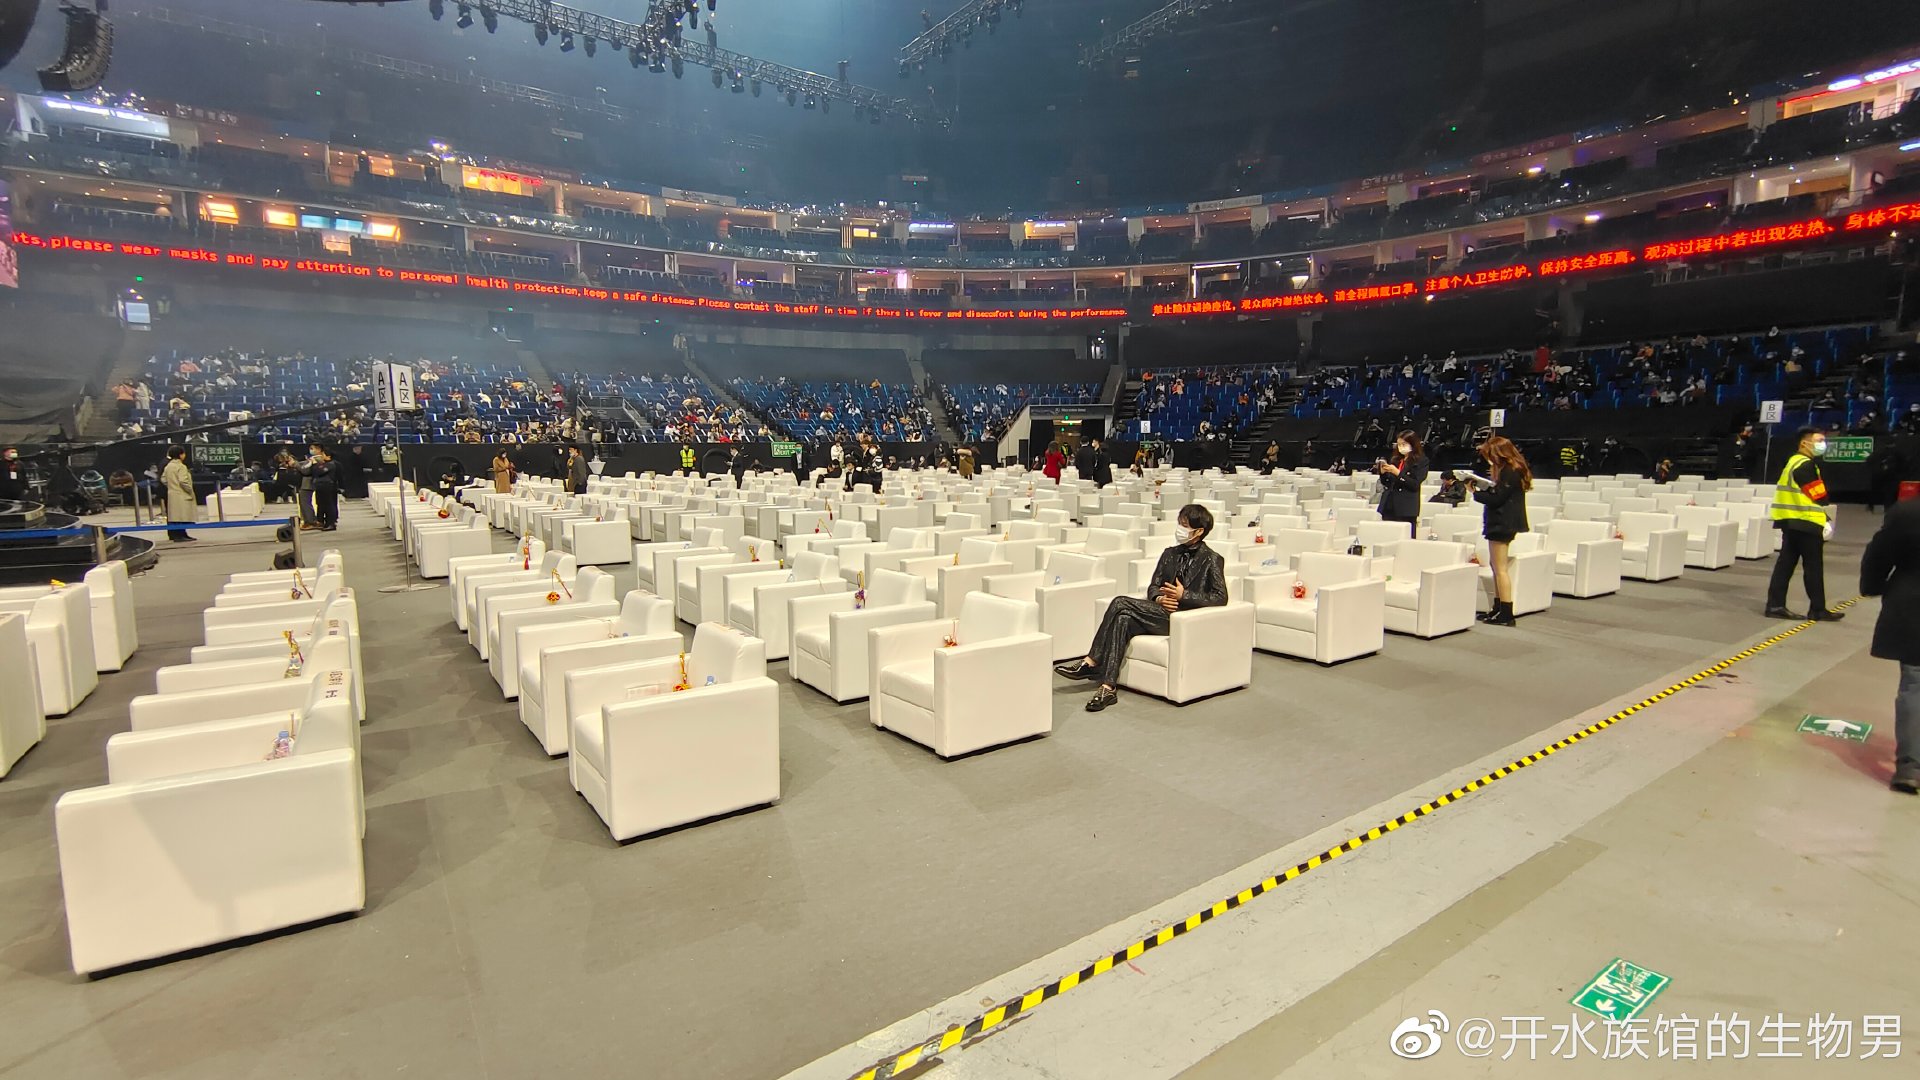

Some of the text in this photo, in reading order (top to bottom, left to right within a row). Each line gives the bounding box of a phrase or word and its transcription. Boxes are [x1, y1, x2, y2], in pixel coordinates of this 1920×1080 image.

[120, 244, 161, 256] wear
[169, 249, 218, 262] masks
[226, 254, 255, 265] and
[261, 258, 289, 270] pay
[296, 260, 371, 276] attention
[376, 266, 394, 278] to
[400, 271, 459, 284] personal
[466, 275, 509, 289] health
[623, 291, 648, 302] safe
[733, 302, 770, 312] contact
[773, 303, 790, 313] the
[793, 305, 819, 314] staff
[824, 306, 834, 314] in
[837, 306, 858, 315] time
[862, 307, 872, 316] if
[875, 308, 901, 317] there
[905, 309, 915, 317] is
[947, 310, 962, 318] and
[1018, 309, 1048, 319] during
[1051, 309, 1067, 318] the
[208, 446, 241, 455] 安全出口
[1838, 450, 1856, 458] EXIT
